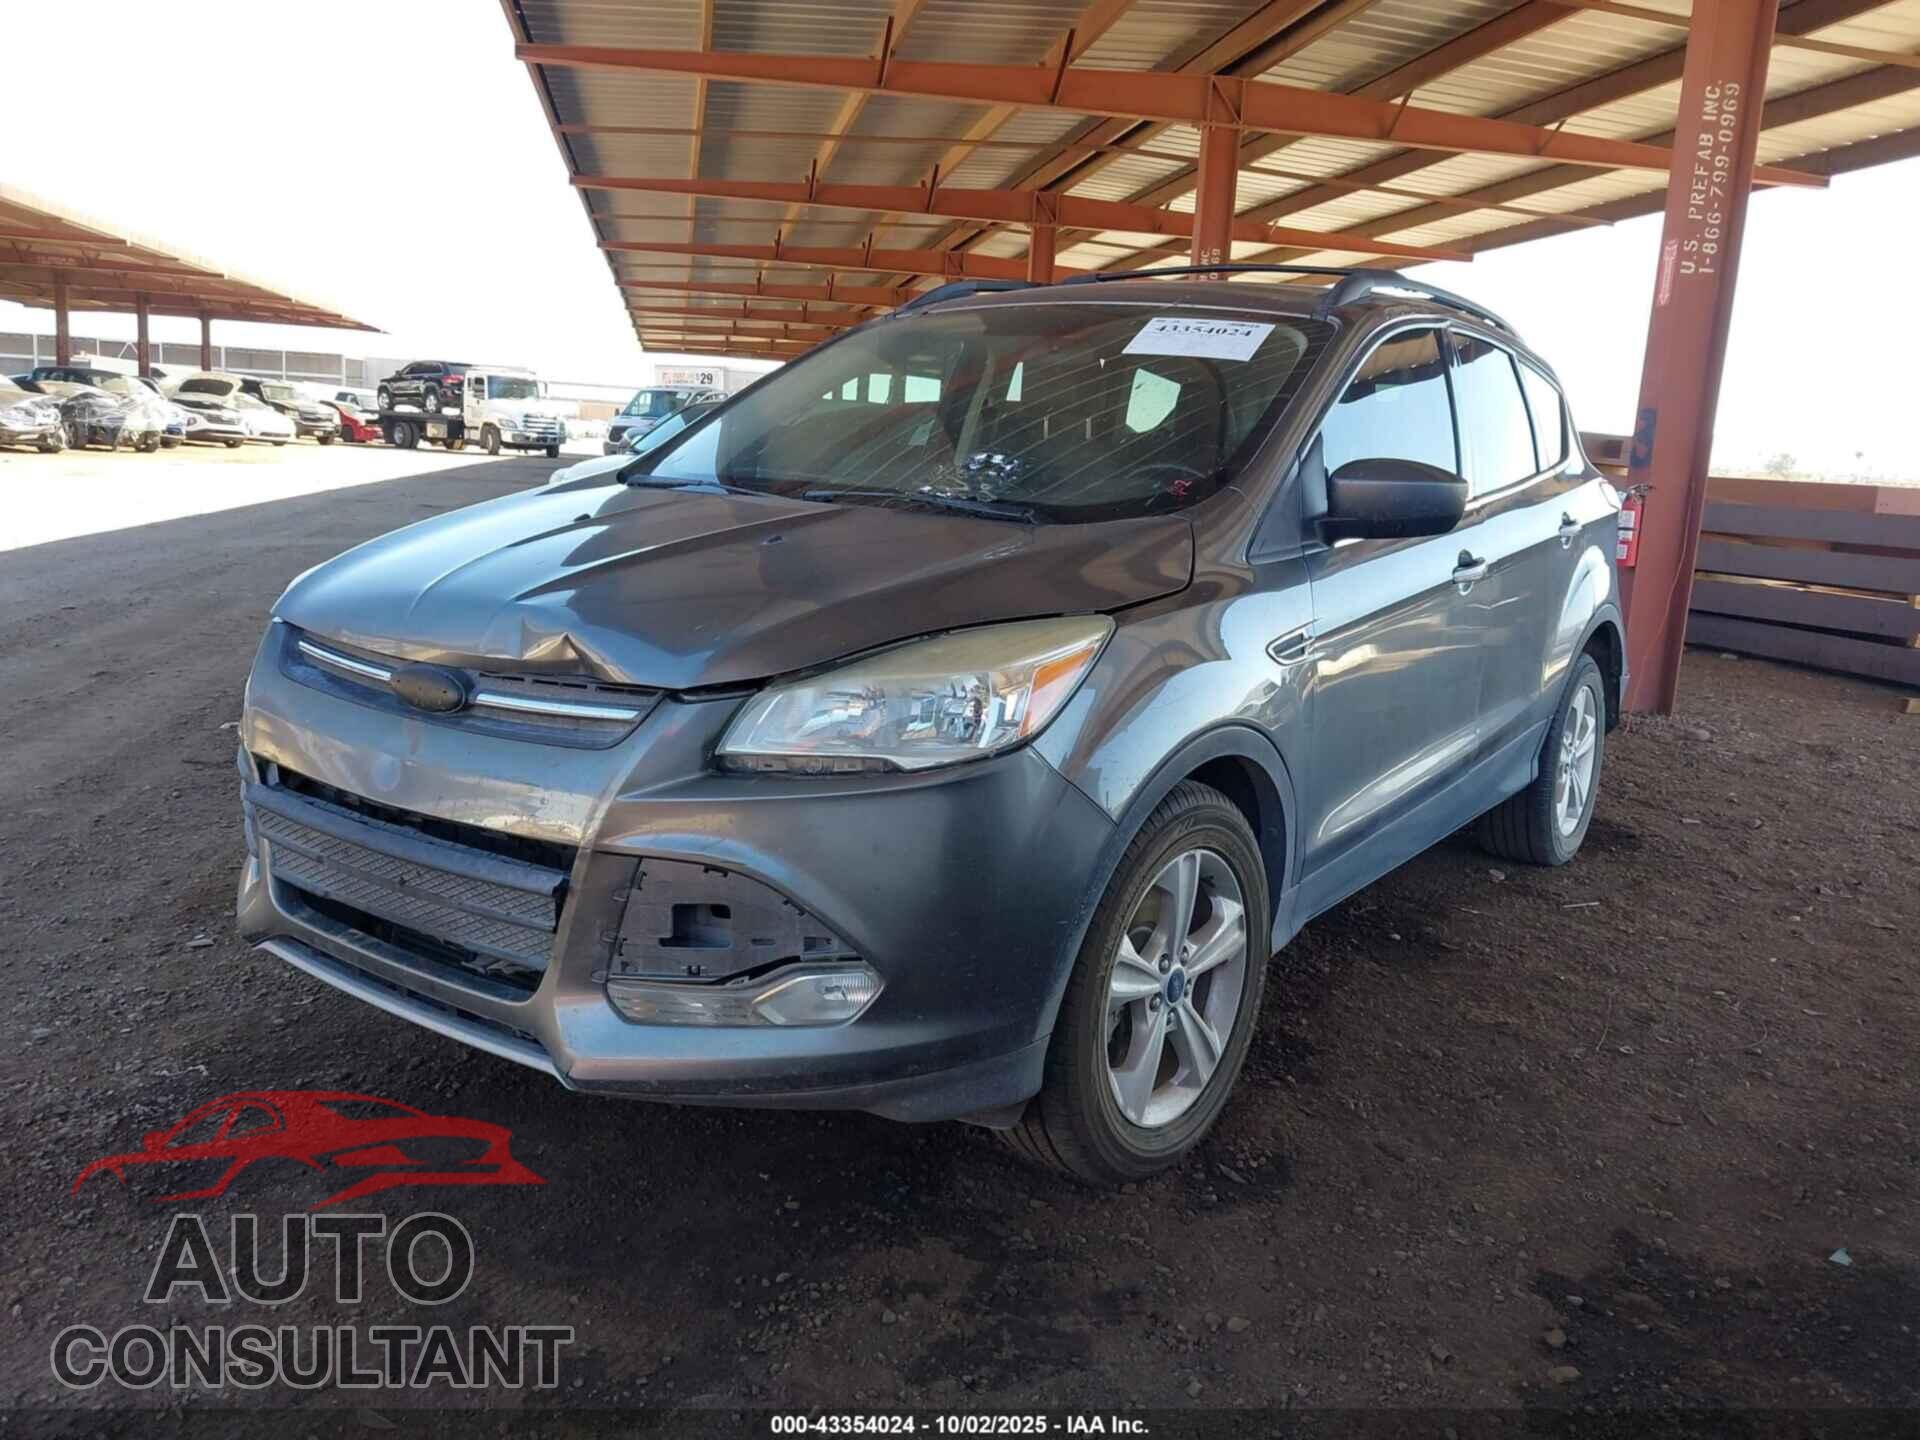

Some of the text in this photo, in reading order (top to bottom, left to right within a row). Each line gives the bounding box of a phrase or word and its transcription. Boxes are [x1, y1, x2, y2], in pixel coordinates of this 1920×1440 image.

[1679, 79, 1723, 274] U.S. PREFAB INC.
[1699, 82, 1741, 274] 1-866-799-0969
